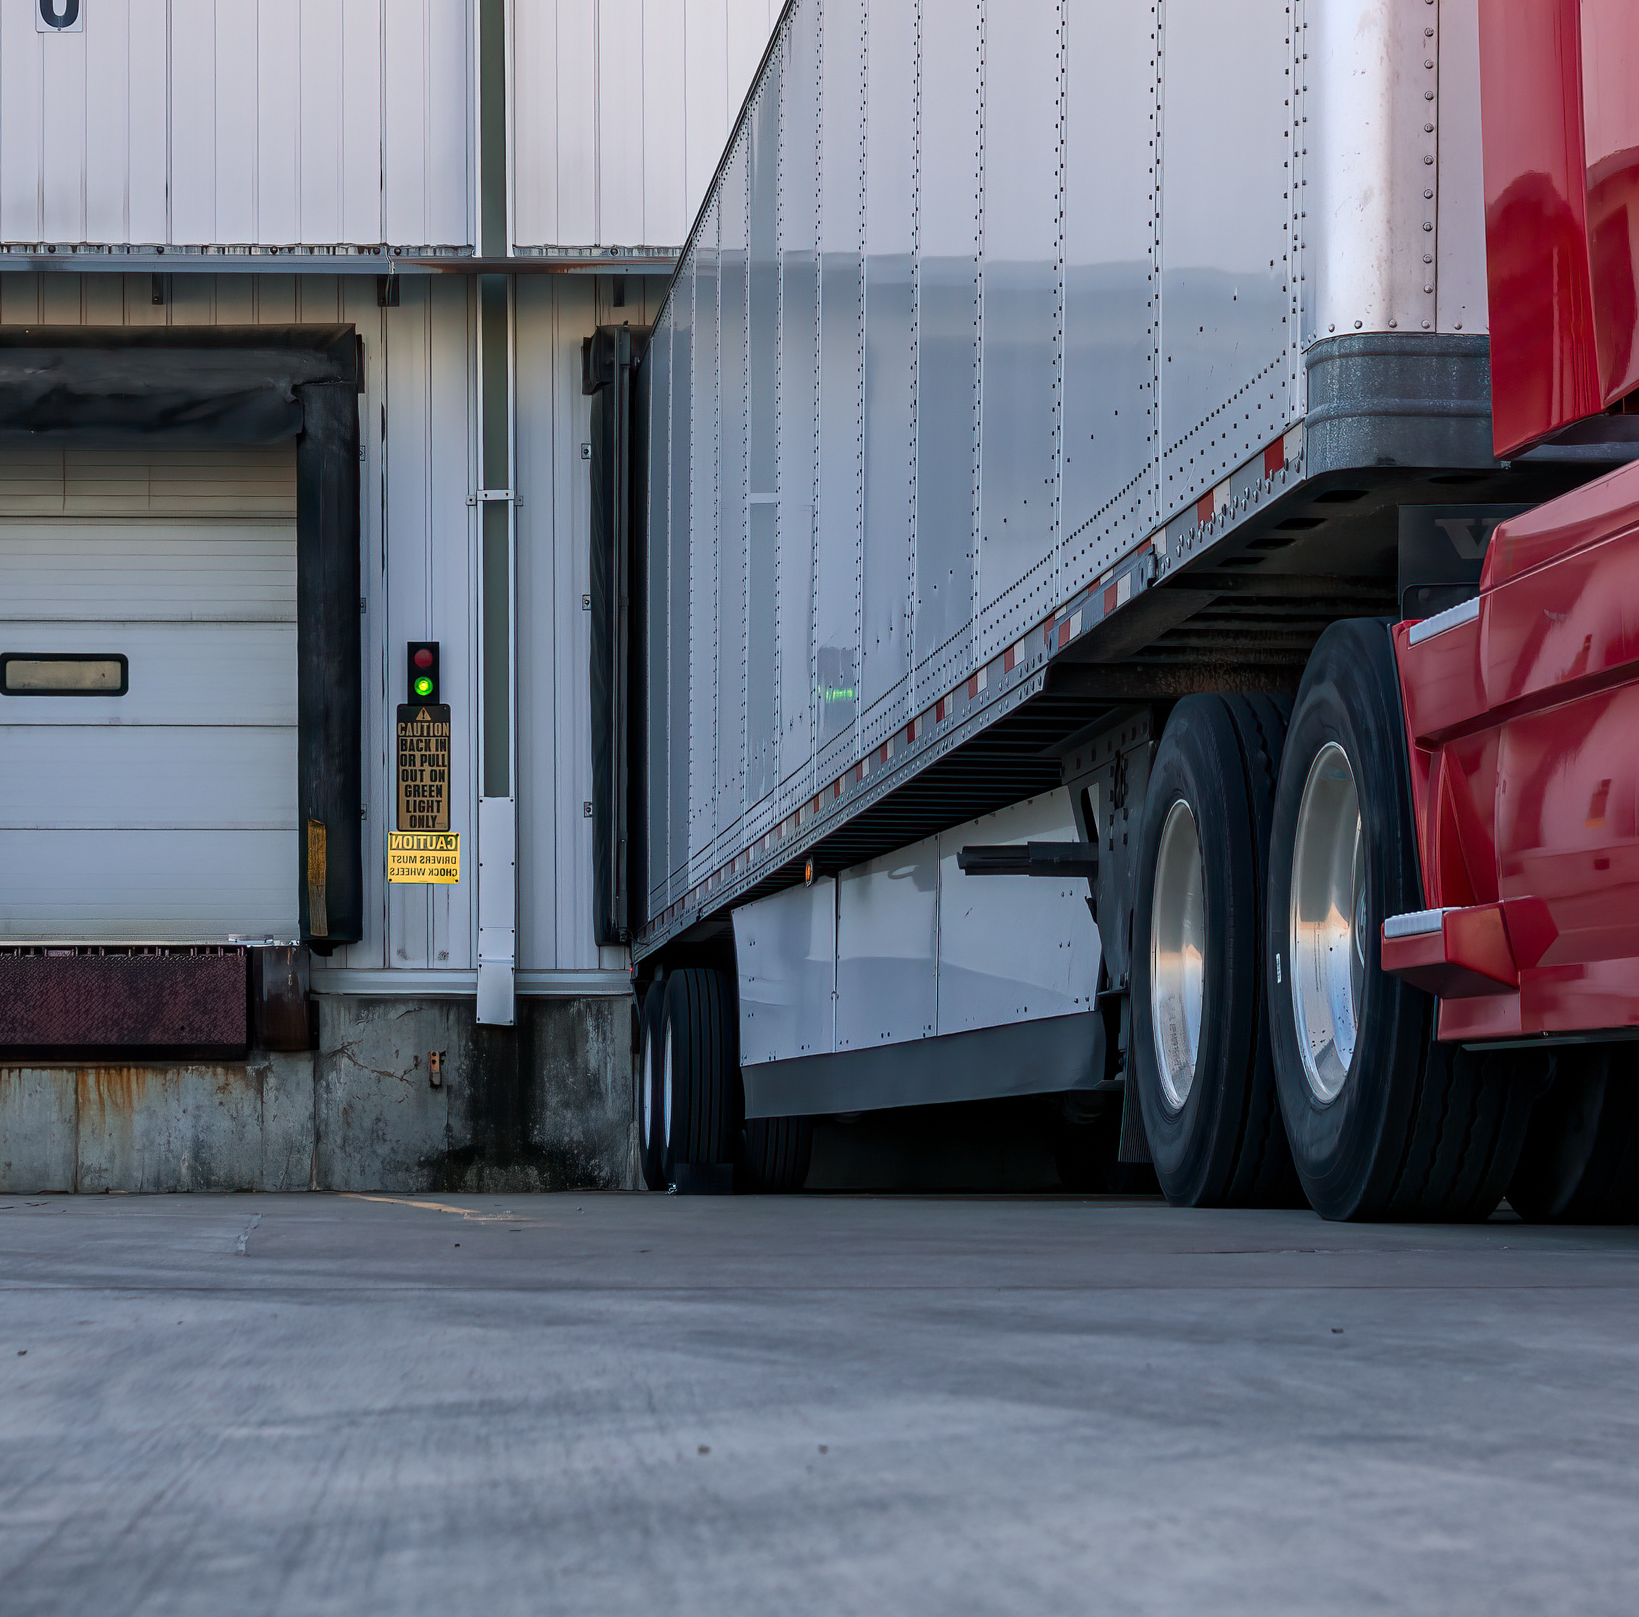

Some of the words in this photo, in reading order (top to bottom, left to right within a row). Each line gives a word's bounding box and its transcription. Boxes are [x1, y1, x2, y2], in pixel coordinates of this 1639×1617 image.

[398, 722, 449, 736] CAUTION
[400, 738, 431, 752] BACK
[435, 738, 446, 752] IN
[400, 753, 416, 767] OR
[420, 753, 447, 767] PULL
[401, 769, 425, 782] OUT
[430, 769, 445, 782] ON
[404, 784, 443, 798] GREEN
[406, 800, 442, 813] LIGHT
[409, 815, 437, 828] ONLY
